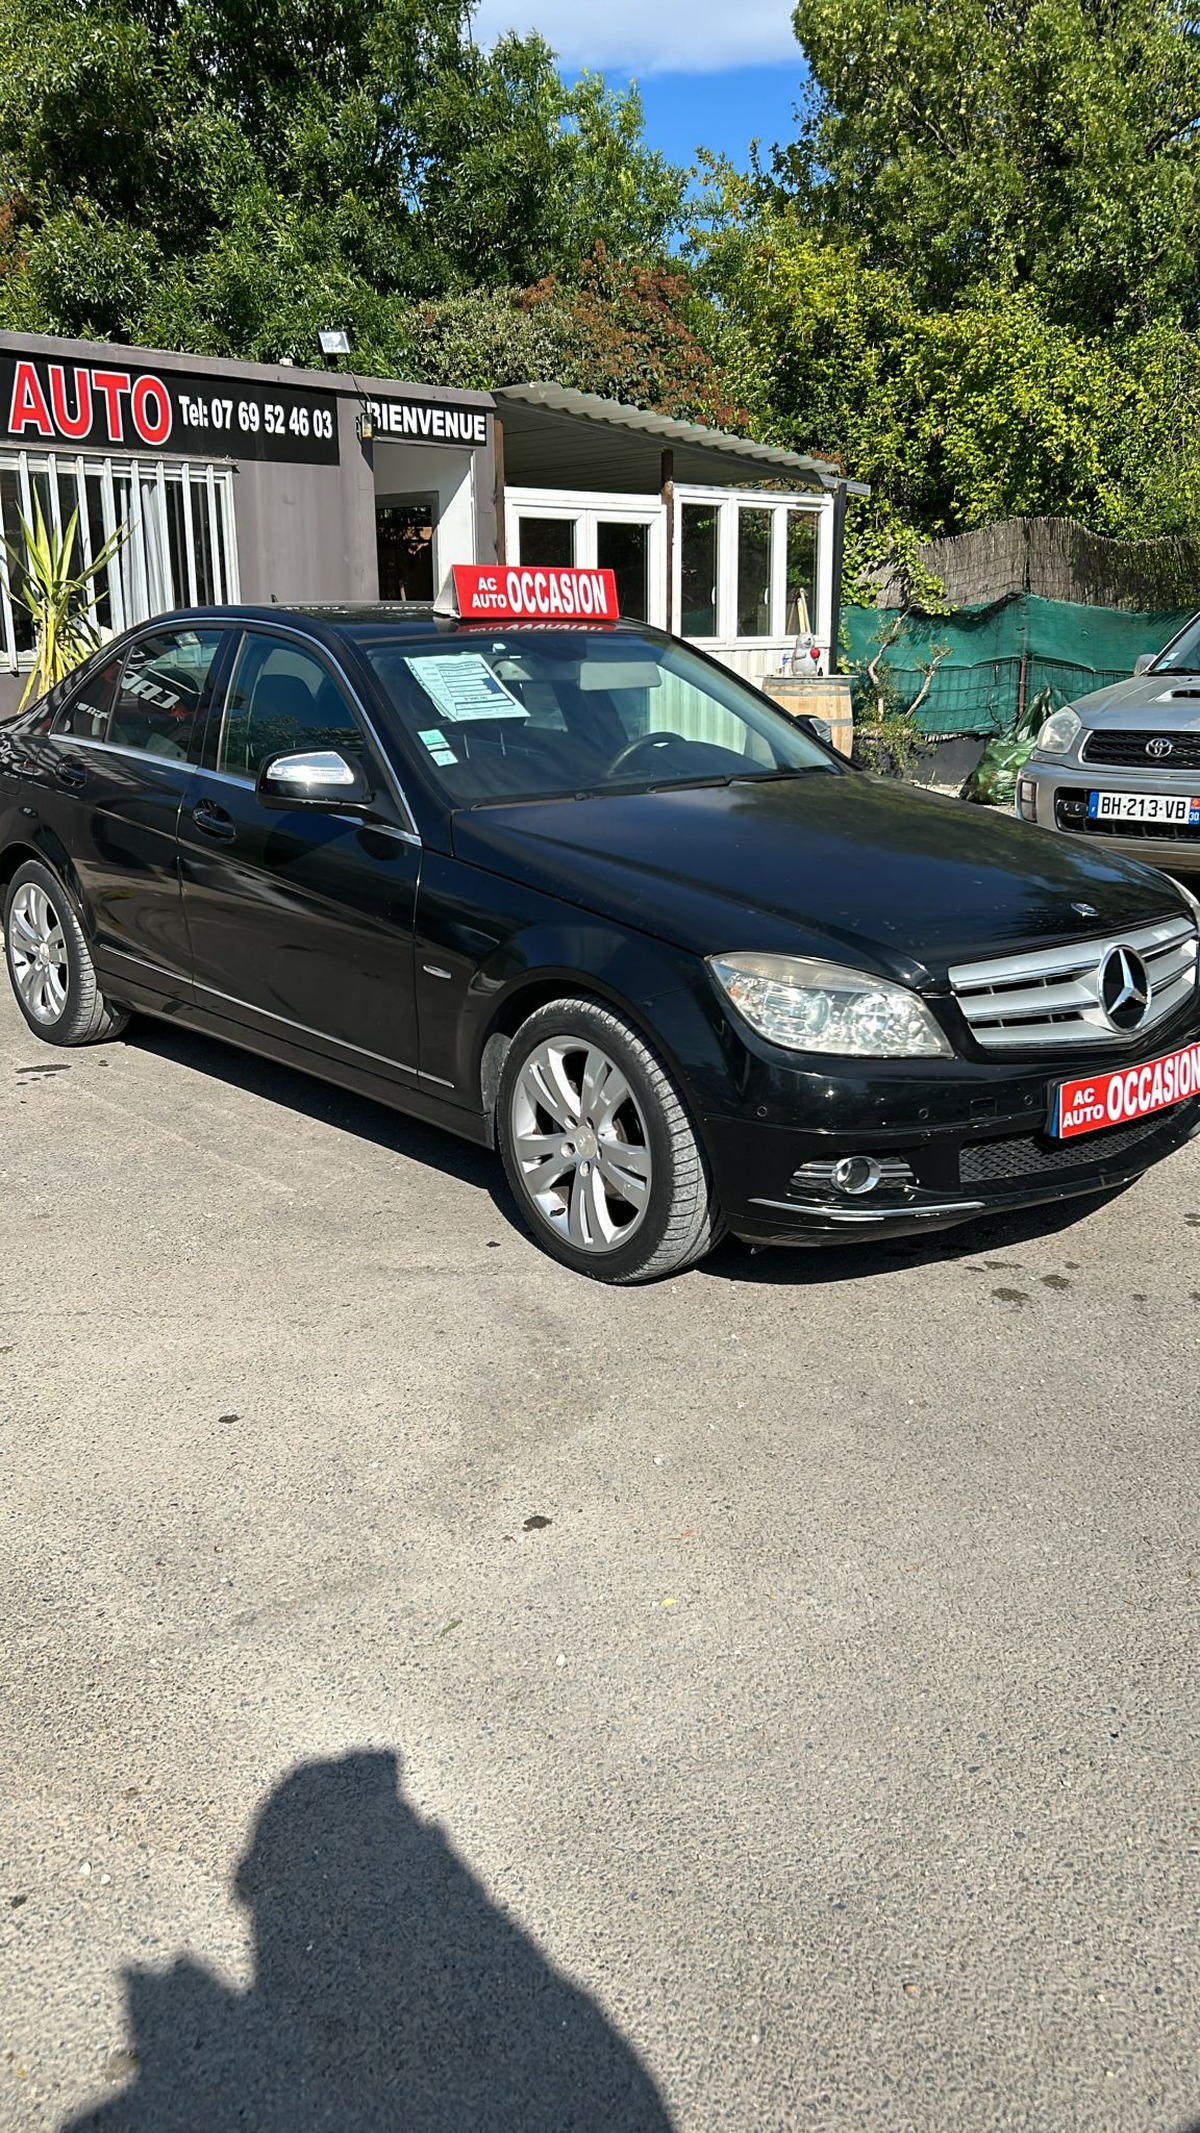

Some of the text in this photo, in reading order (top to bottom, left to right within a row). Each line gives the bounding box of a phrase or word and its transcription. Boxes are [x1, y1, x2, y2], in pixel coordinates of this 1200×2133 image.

[8, 361, 173, 446] AUTO
[178, 395, 333, 439] Tel: 07 69 52 46 03
[366, 401, 486, 441] BIENVENUE
[478, 577, 497, 591] AC
[506, 571, 608, 614] OCCASION
[472, 593, 507, 609] AUTO
[1101, 796, 1186, 820] BH-213-VB
[1189, 811, 1199, 821] 30
[1106, 1046, 1200, 1121] OCCASION
[1073, 1088, 1095, 1106] AC
[1063, 1104, 1104, 1128] AUTO
